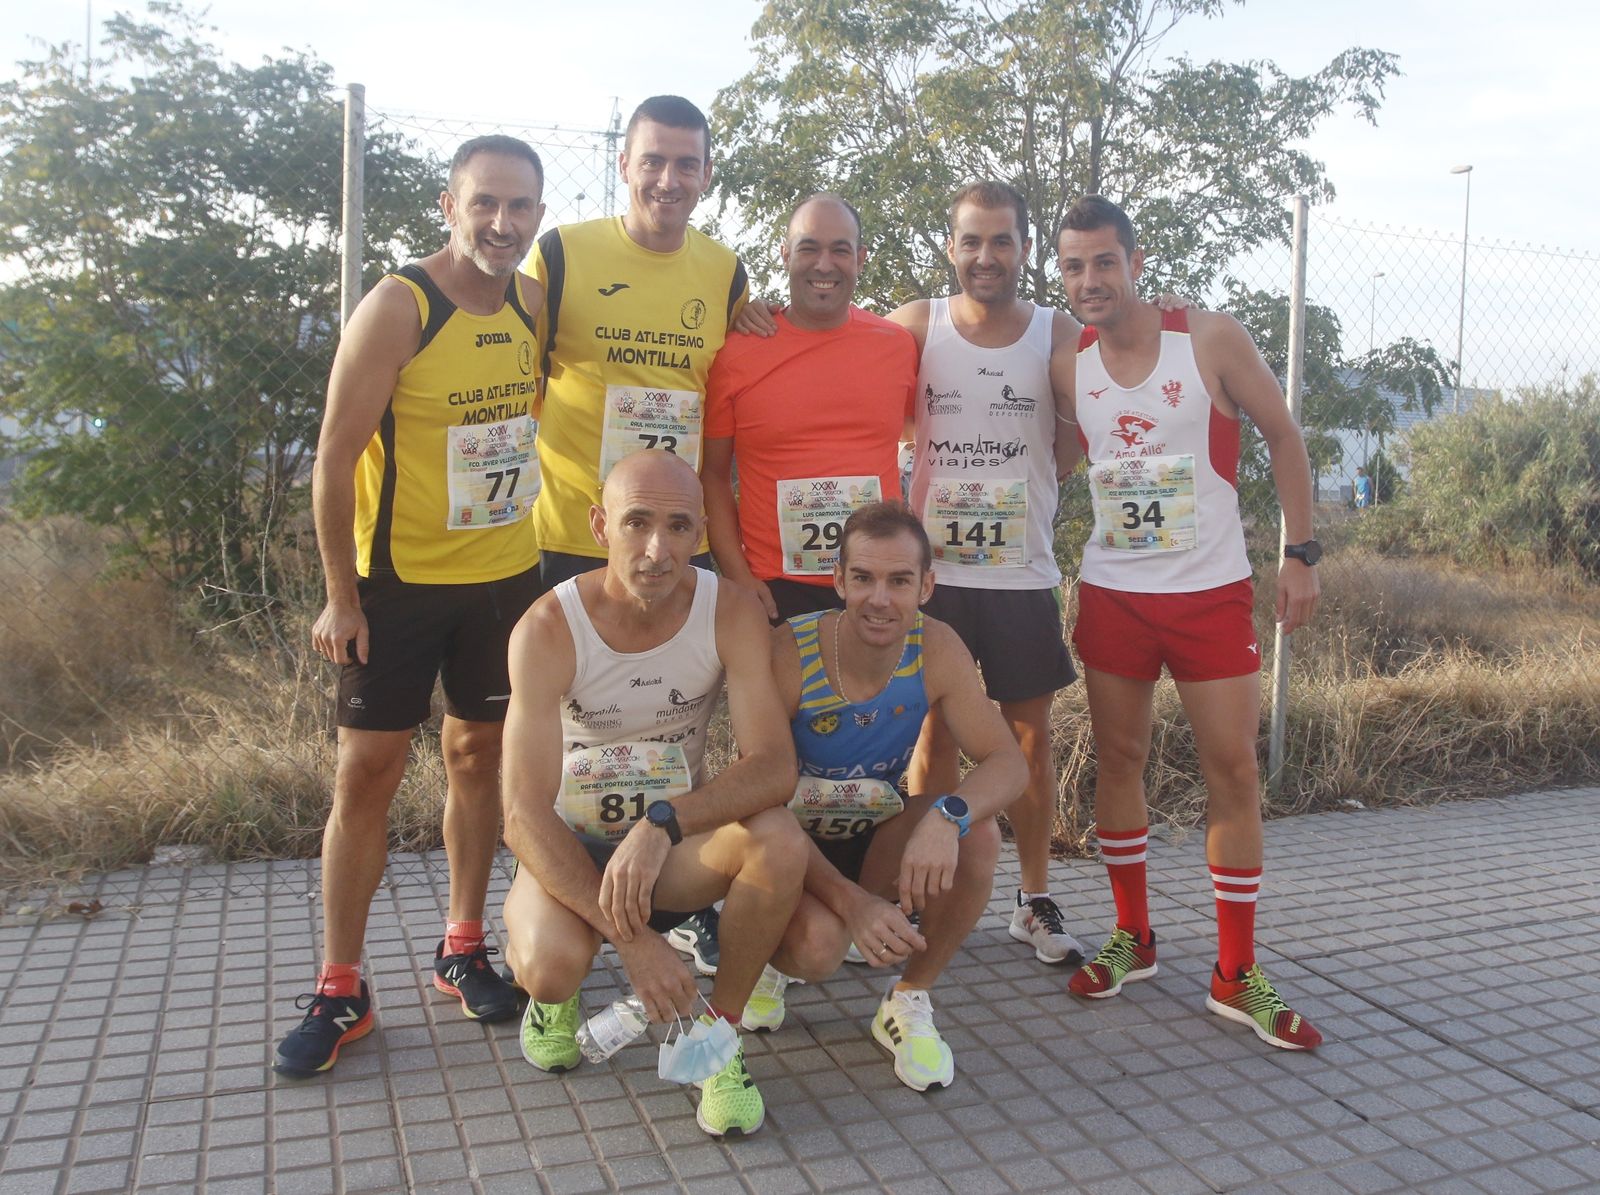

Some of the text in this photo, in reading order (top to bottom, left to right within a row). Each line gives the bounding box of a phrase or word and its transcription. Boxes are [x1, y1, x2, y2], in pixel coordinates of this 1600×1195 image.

[595, 326, 704, 349] CLUB ATLETISMO
[606, 346, 691, 369] MONTILLA
[448, 381, 536, 406] CLUB ATLETISMO
[644, 392, 672, 402] XXXV
[461, 401, 528, 425] MONTILLA
[487, 425, 509, 437] XXXV
[928, 457, 1001, 469] viajes
[1119, 460, 1146, 470] XXXV
[485, 467, 521, 502] 77
[811, 481, 838, 491] XXXV
[958, 482, 984, 491] XXXV
[1121, 501, 1165, 530] 34
[945, 520, 1006, 547] 141
[601, 745, 633, 758] XXXV
[580, 783, 603, 791] RAFAEL
[634, 778, 671, 786] SALAMANCA
[832, 783, 861, 794] XXXV
[599, 793, 647, 824] 81
[804, 817, 874, 836] 150
